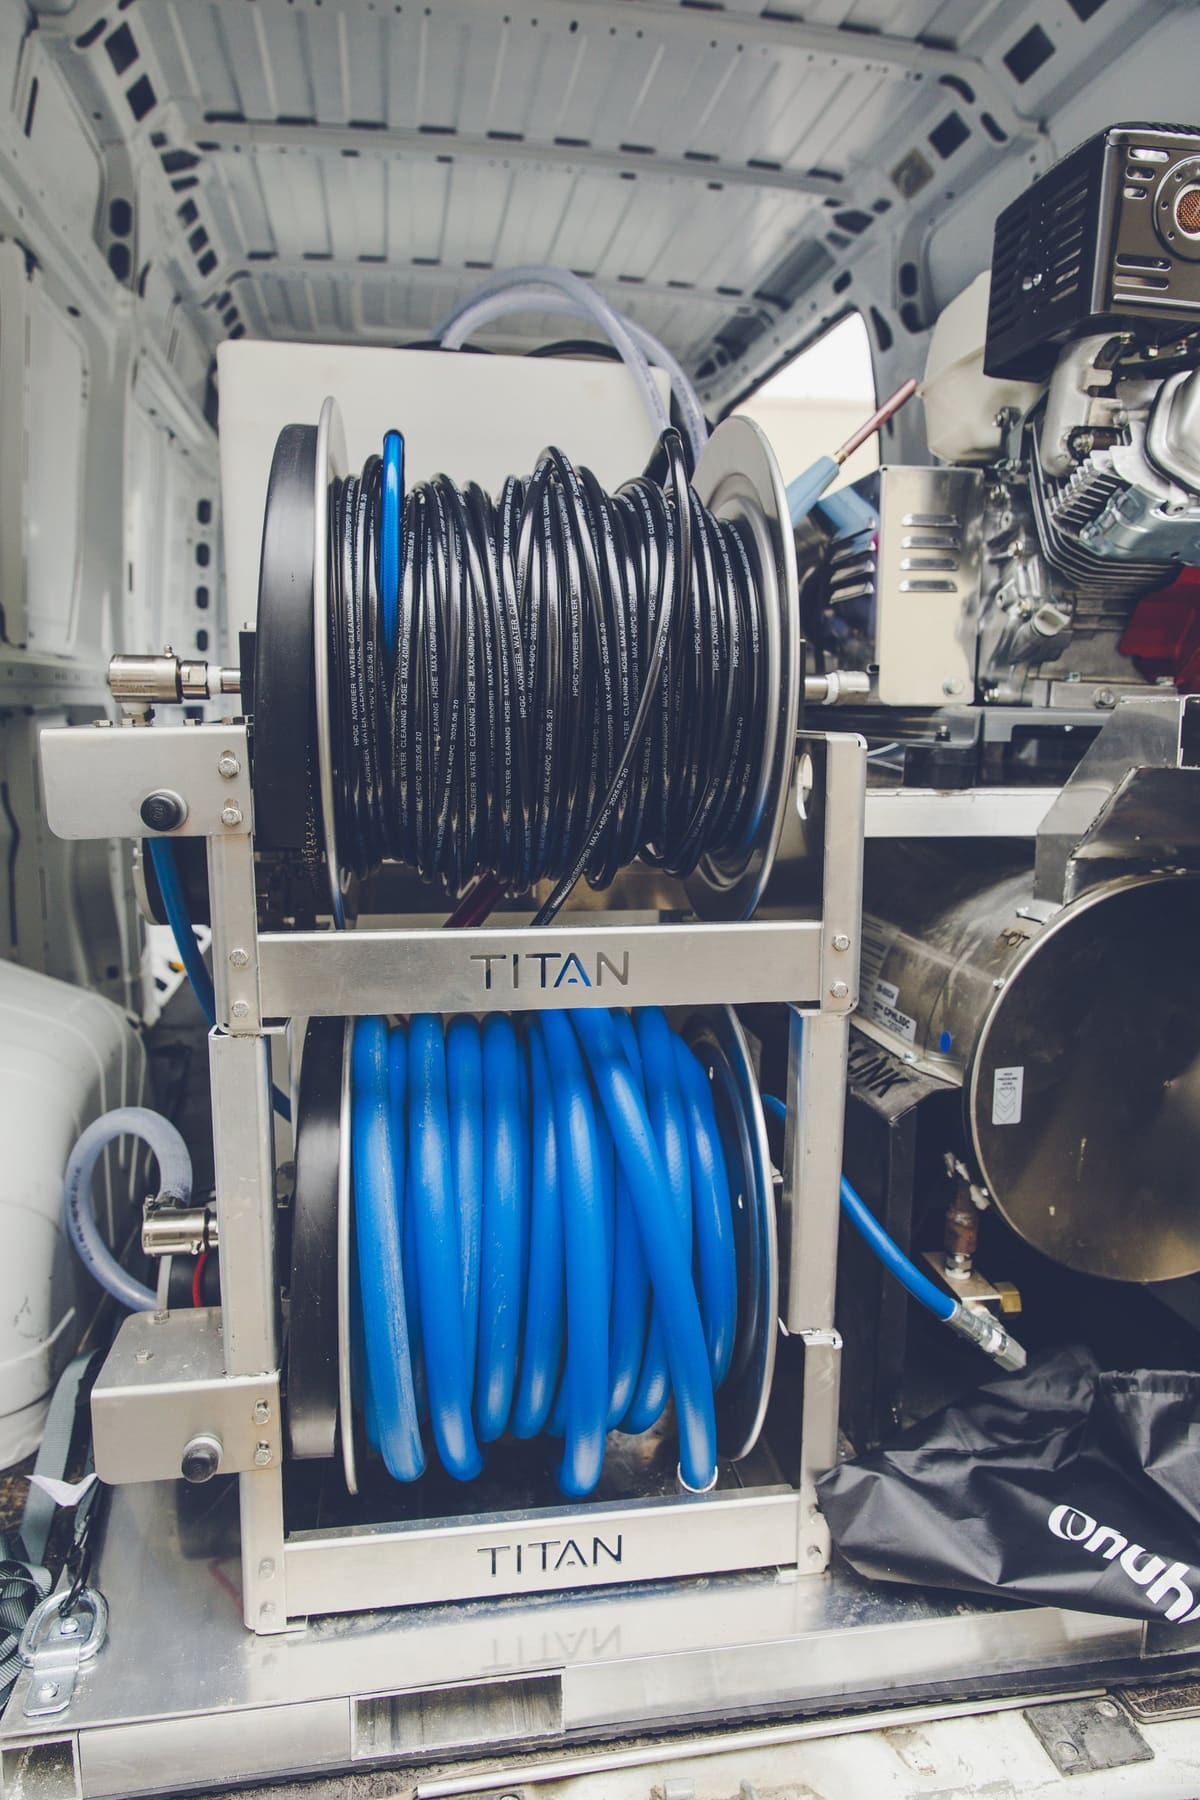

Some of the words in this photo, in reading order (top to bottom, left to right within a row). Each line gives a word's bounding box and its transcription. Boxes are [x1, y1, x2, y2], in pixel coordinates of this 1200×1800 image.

[599, 505, 611, 532] 2025.06.20
[645, 509, 655, 534] CLEANING
[347, 603, 355, 643] CLEANING
[511, 619, 521, 648] WATER
[710, 609, 719, 645] AOWEIER
[599, 622, 609, 664] 2025.06.20
[658, 636, 667, 657] HPGC
[366, 640, 374, 682] 2025.06.20
[515, 653, 525, 691] AOWEIER
[620, 650, 628, 672] HOSE
[712, 649, 720, 671] HPGC
[350, 683, 358, 720] AOWEIER
[400, 683, 408, 705] HOSE
[468, 681, 476, 703] HOSE
[518, 695, 527, 718] HPGC
[622, 677, 630, 716] CLEANING
[450, 699, 459, 740] 2025.06.20
[503, 700, 511, 722] HOSE
[352, 725, 360, 746] HPGC
[545, 709, 554, 750] 2025.06.20
[504, 769, 512, 796] WATER
[608, 767, 629, 806] 2025.06.20
[470, 951, 629, 990] TITAN
[477, 1534, 623, 1577] TITAN
